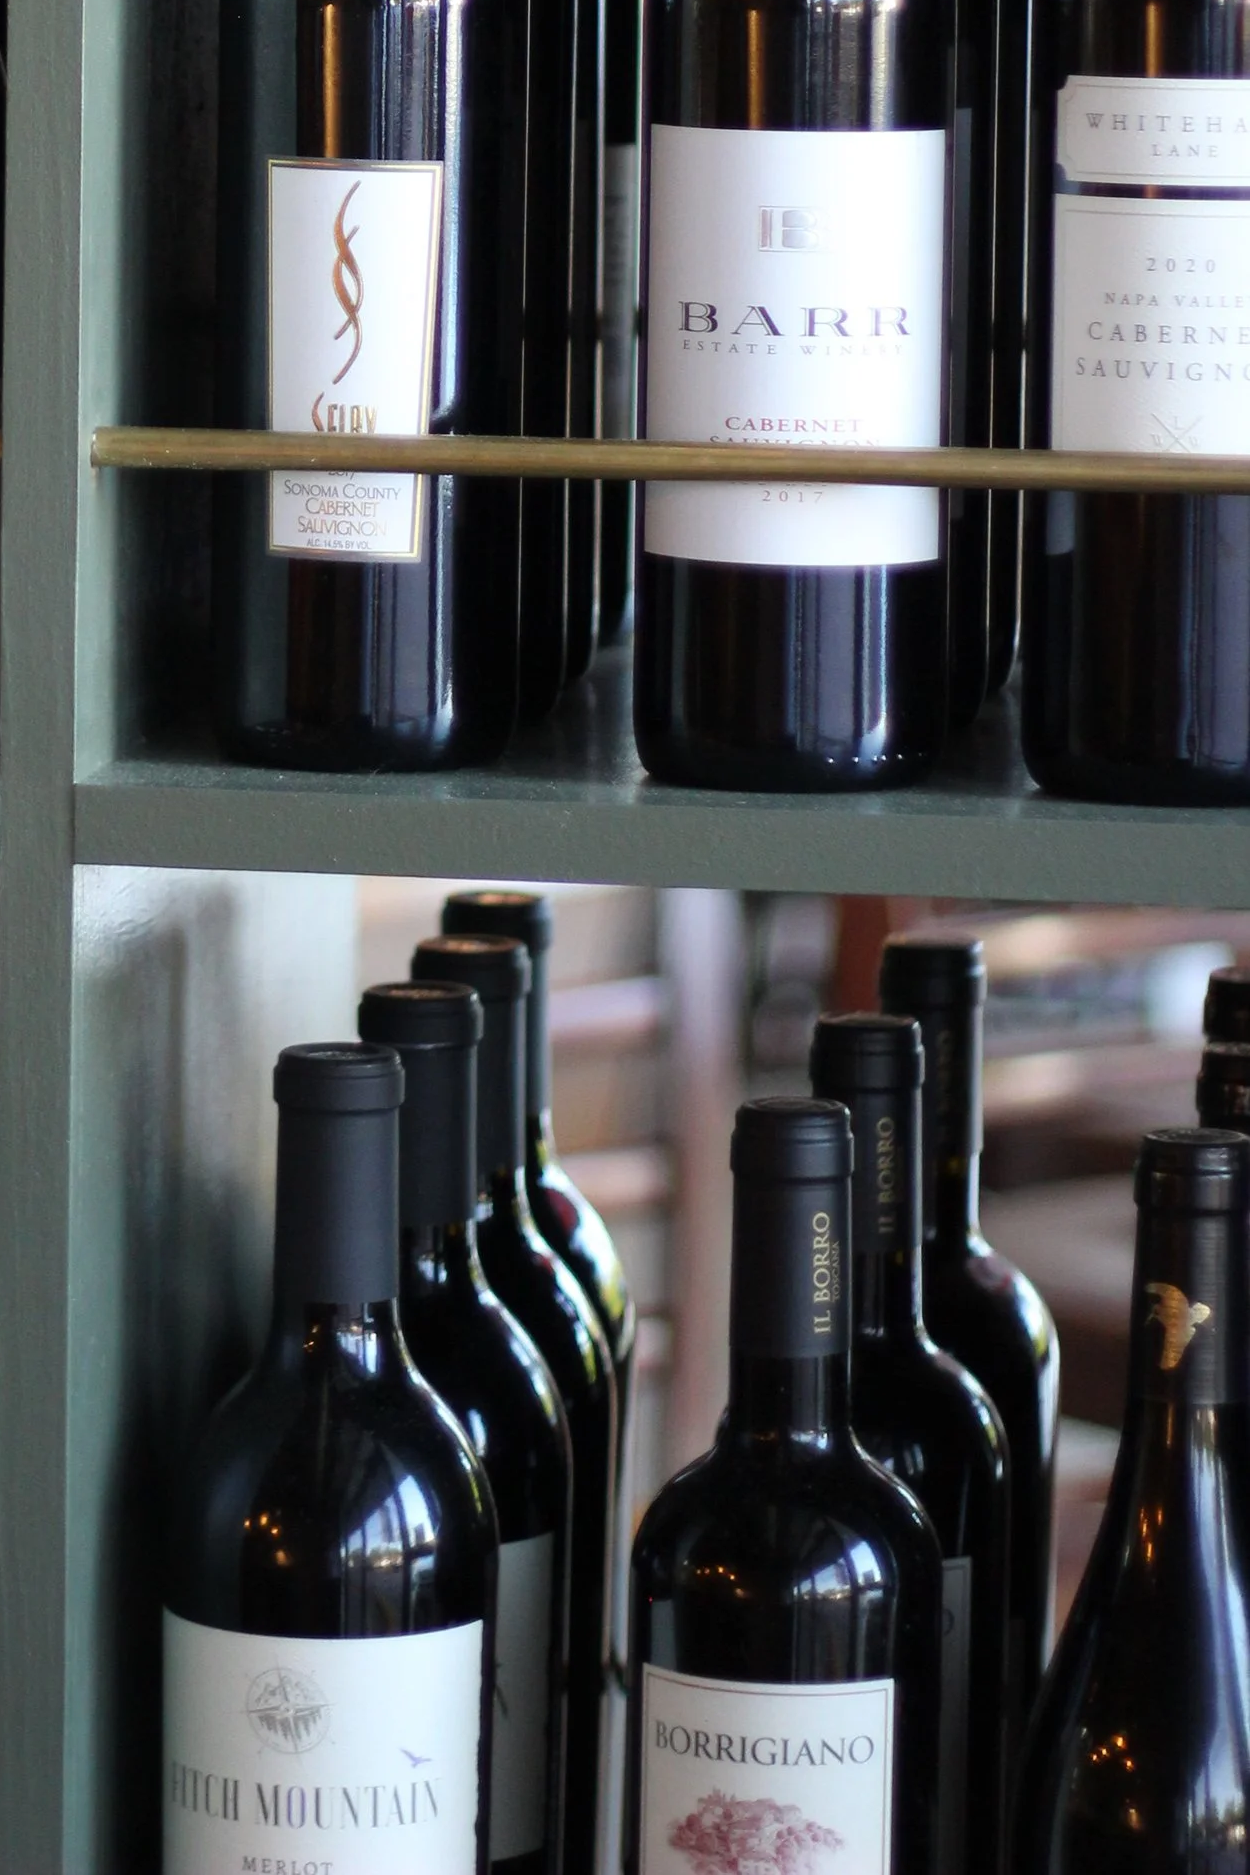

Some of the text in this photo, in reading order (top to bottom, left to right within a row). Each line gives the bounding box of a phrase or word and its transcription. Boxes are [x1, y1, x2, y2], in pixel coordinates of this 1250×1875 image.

[1153, 145, 1219, 158] LANE
[1147, 258, 1217, 273] 2020
[1104, 293, 1250, 308] NAPA VALLE
[678, 301, 910, 336] BARR
[683, 340, 903, 356] ESTATE WINERY
[725, 416, 862, 434] CABERNET
[284, 479, 401, 500] SONOMA COUNTY
[762, 490, 823, 503] 2017
[305, 497, 380, 517] CABERNET
[298, 516, 387, 536] SAUVIGNON
[876, 1116, 894, 1204] BORRO
[813, 1211, 831, 1335] IL BORRO
[831, 1240, 840, 1303] TOSCANA
[655, 1719, 875, 1768] BORRIGIANO
[254, 1777, 441, 1831] MOUNTAIN
[242, 1856, 334, 1875] MERLOT
